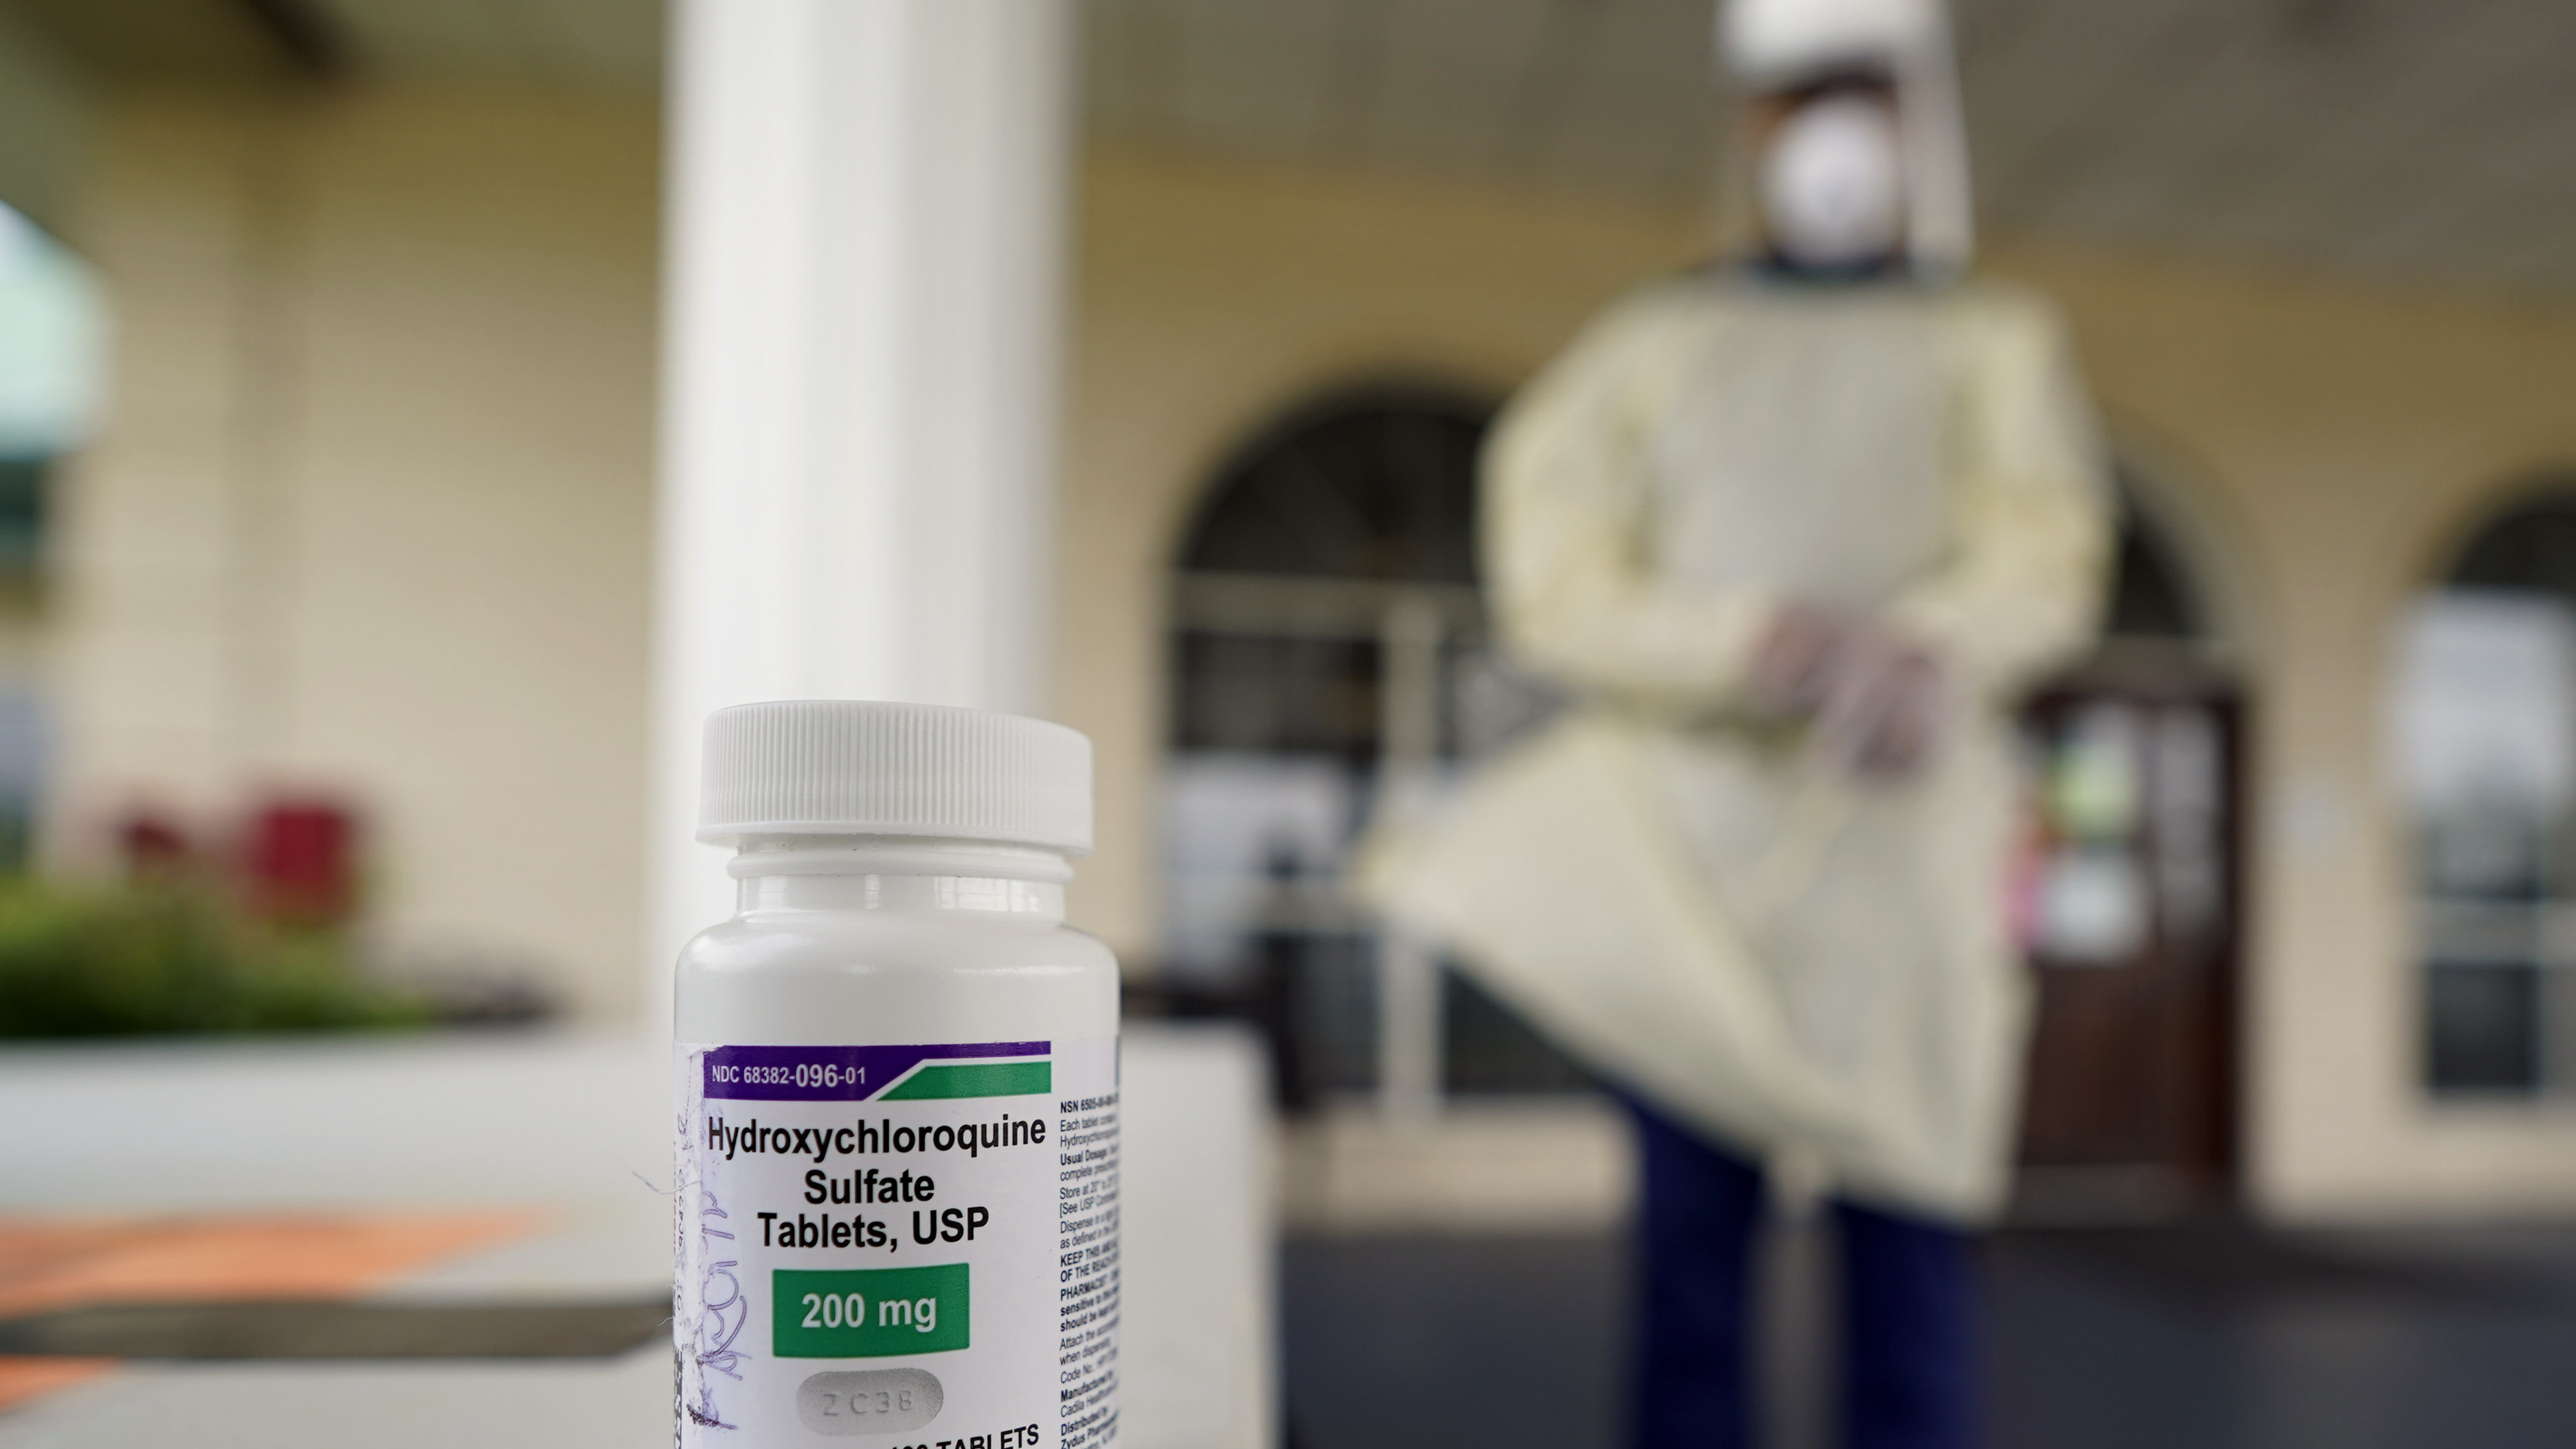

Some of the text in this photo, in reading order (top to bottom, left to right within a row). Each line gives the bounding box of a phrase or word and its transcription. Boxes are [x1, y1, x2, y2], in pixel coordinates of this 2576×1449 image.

[712, 1063, 866, 1088] NDC 68382-096-01
[1060, 1100, 1079, 1113] NSN
[1060, 1118, 1079, 1132] Each
[708, 1113, 1046, 1163] Hydroxychloroquine
[1060, 1151, 1083, 1165] Usual
[1060, 1166, 1092, 1181] complete
[804, 1169, 935, 1204] Sulfate
[1060, 1187, 1080, 1199] Store
[1060, 1202, 1078, 1218] [See
[1080, 1196, 1094, 1211] USP
[757, 1206, 990, 1253] Tablets, USP
[1060, 1217, 1093, 1234] Dispense
[1060, 1239, 1070, 1249] as
[1060, 1251, 1083, 1267] KEEP
[1060, 1269, 1073, 1282] OF
[1075, 1264, 1090, 1279] THE
[801, 1293, 936, 1333] 200 mg
[1060, 1298, 1094, 1316] sensitive
[1060, 1313, 1087, 1332] should
[1060, 1332, 1083, 1351] Attach
[1060, 1351, 1080, 1366] when
[1061, 1368, 1081, 1384] Code
